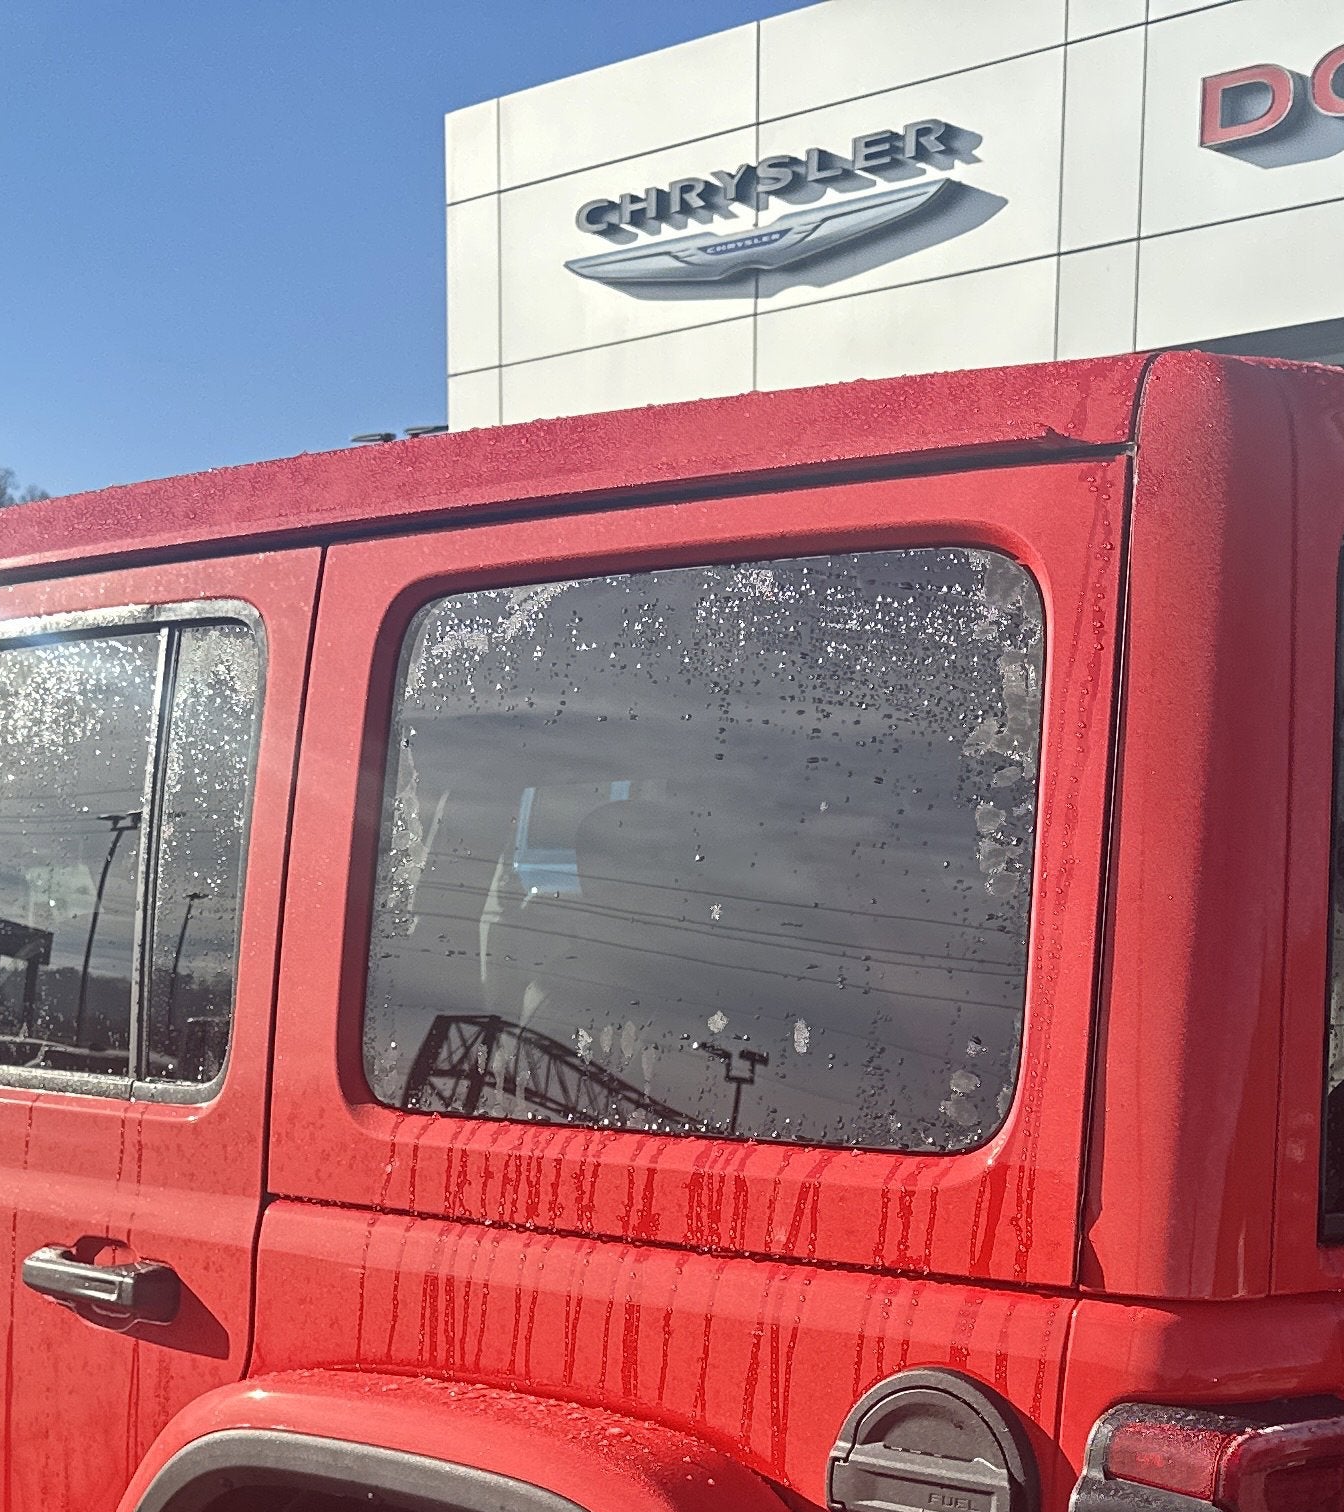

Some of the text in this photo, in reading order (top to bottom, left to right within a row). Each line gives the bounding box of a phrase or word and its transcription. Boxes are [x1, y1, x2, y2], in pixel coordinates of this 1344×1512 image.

[575, 118, 947, 234] CHRYSLER
[705, 233, 781, 254] CHRYSLER
[928, 1493, 981, 1512] FUEL
